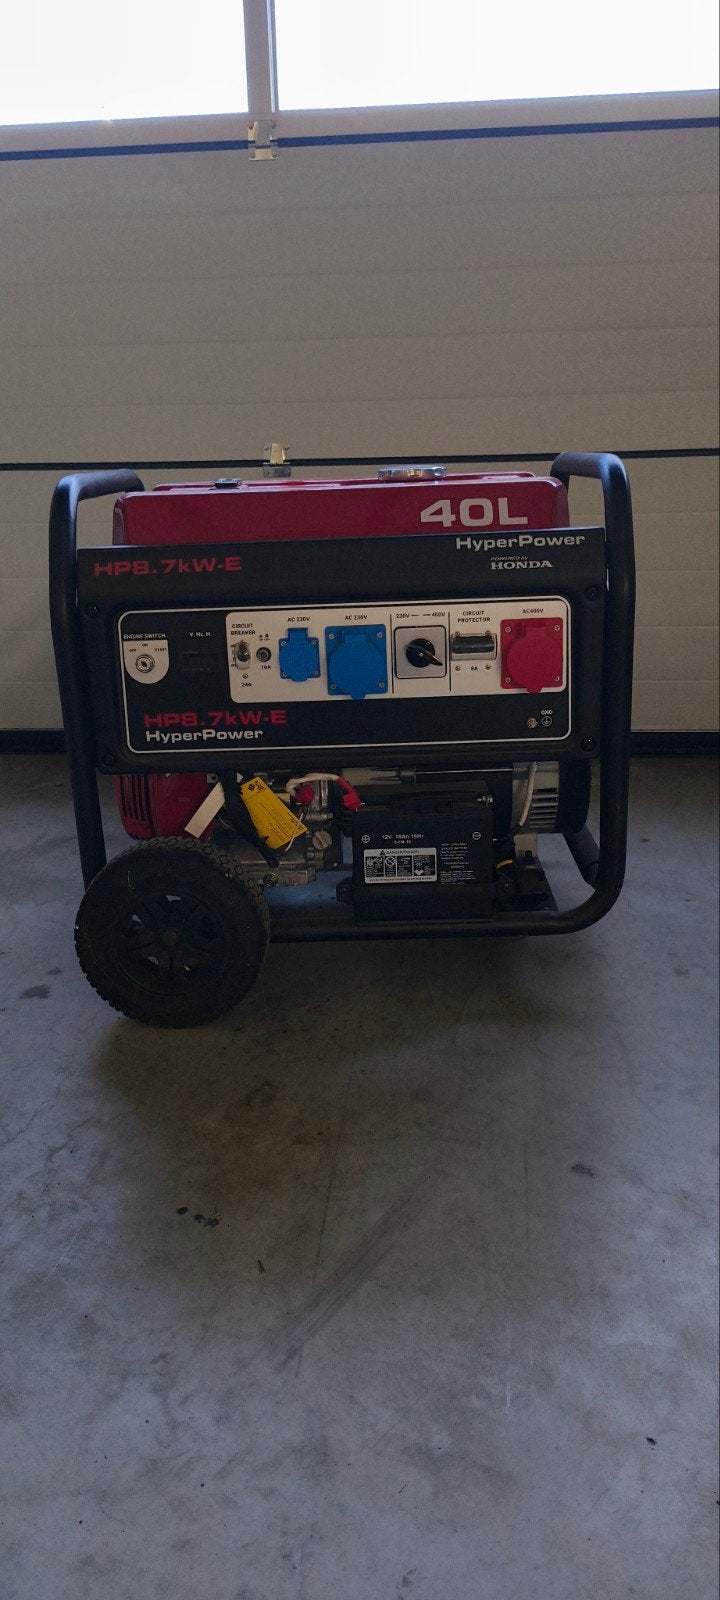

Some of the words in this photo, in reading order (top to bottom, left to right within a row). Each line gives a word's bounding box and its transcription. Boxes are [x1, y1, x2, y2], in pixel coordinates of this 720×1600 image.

[420, 497, 529, 528] 40L
[455, 534, 586, 552] HyperPower
[94, 556, 242, 577] HP8.7kW-E
[490, 560, 554, 570] HONDA
[143, 709, 287, 728] HP8.7kW-E
[145, 728, 264, 744] HyperPower
